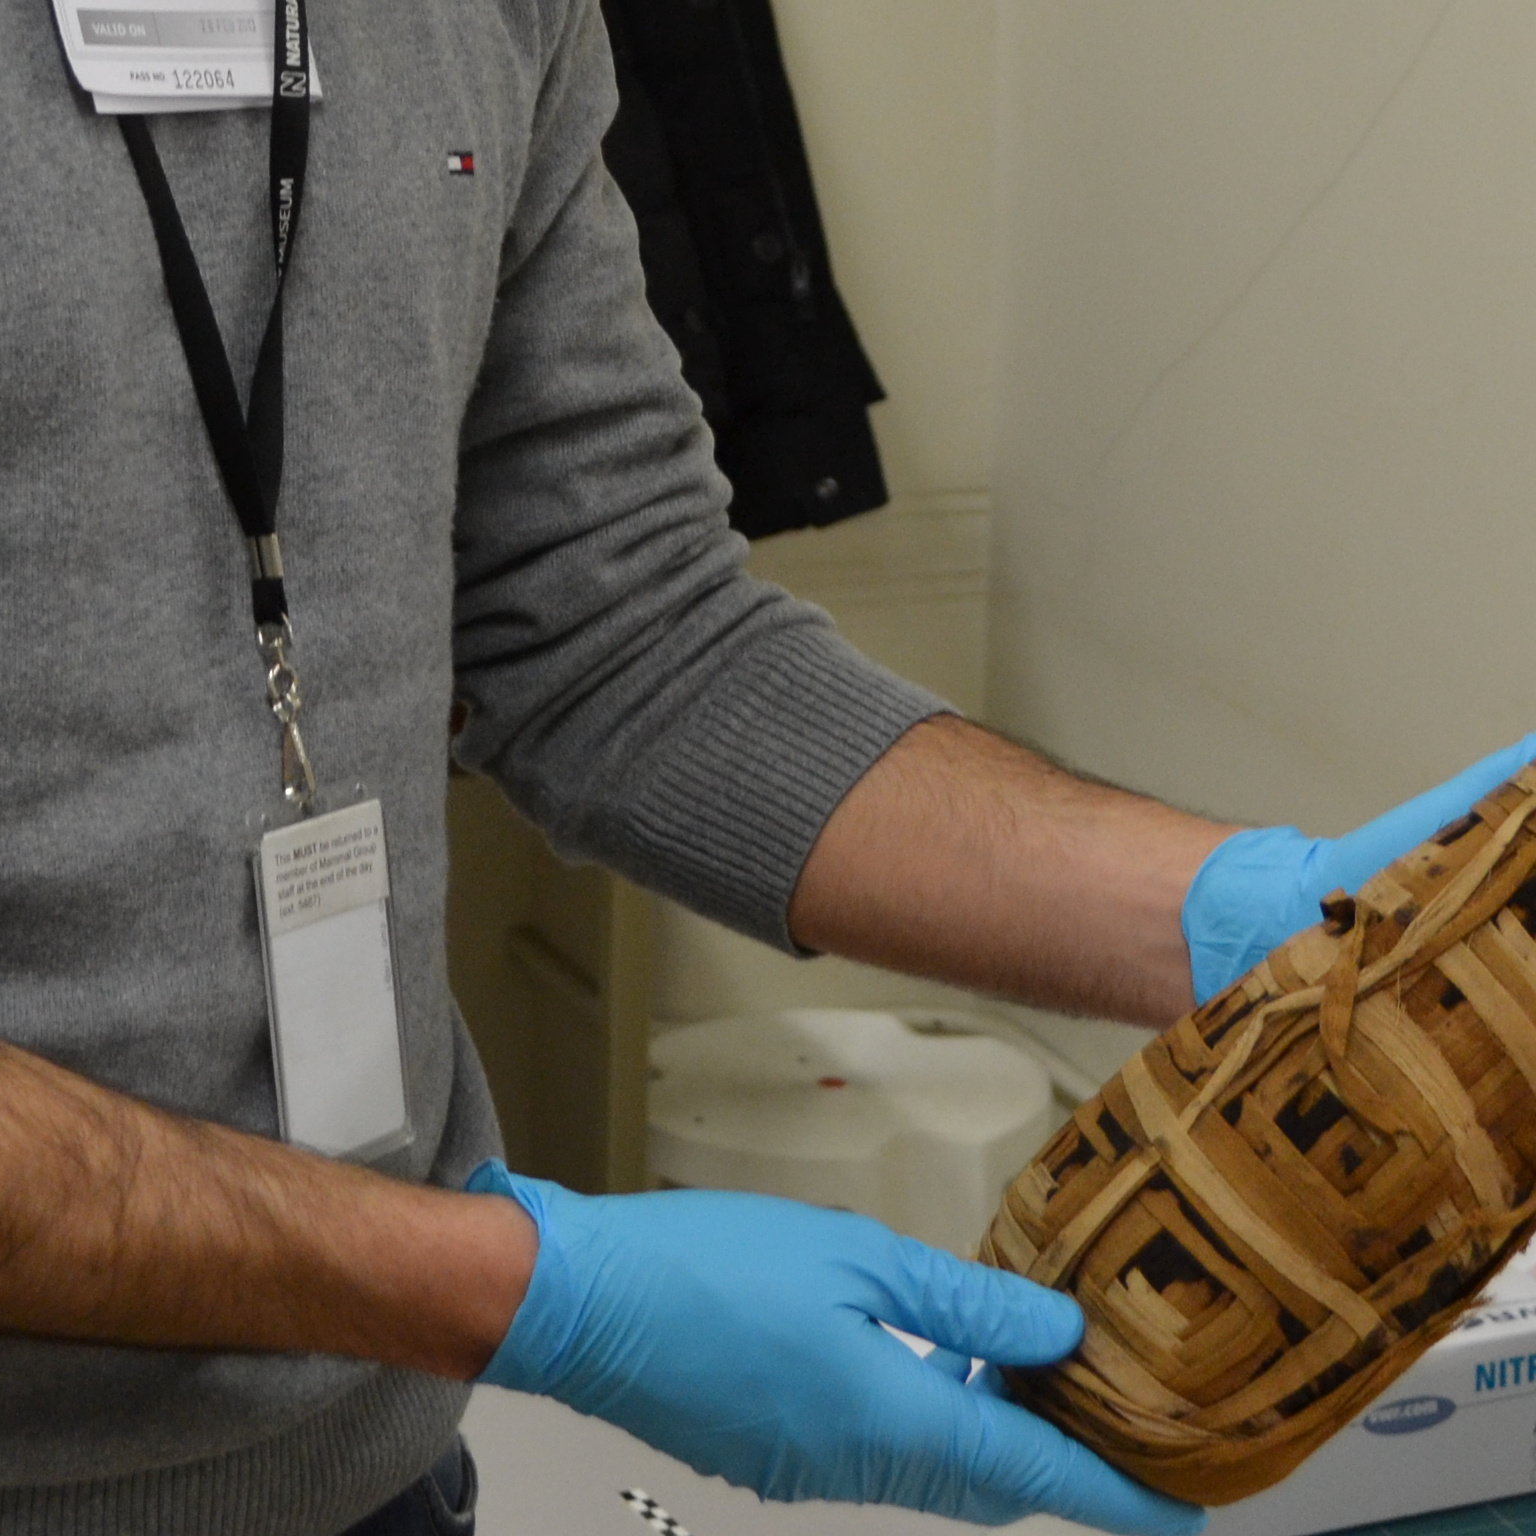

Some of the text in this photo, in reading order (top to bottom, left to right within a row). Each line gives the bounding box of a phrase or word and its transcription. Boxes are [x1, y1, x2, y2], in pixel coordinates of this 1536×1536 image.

[91, 22, 146, 37] VALID ON
[130, 71, 150, 82] PASS
[172, 69, 236, 89] 122064
[293, 843, 317, 861] MUST
